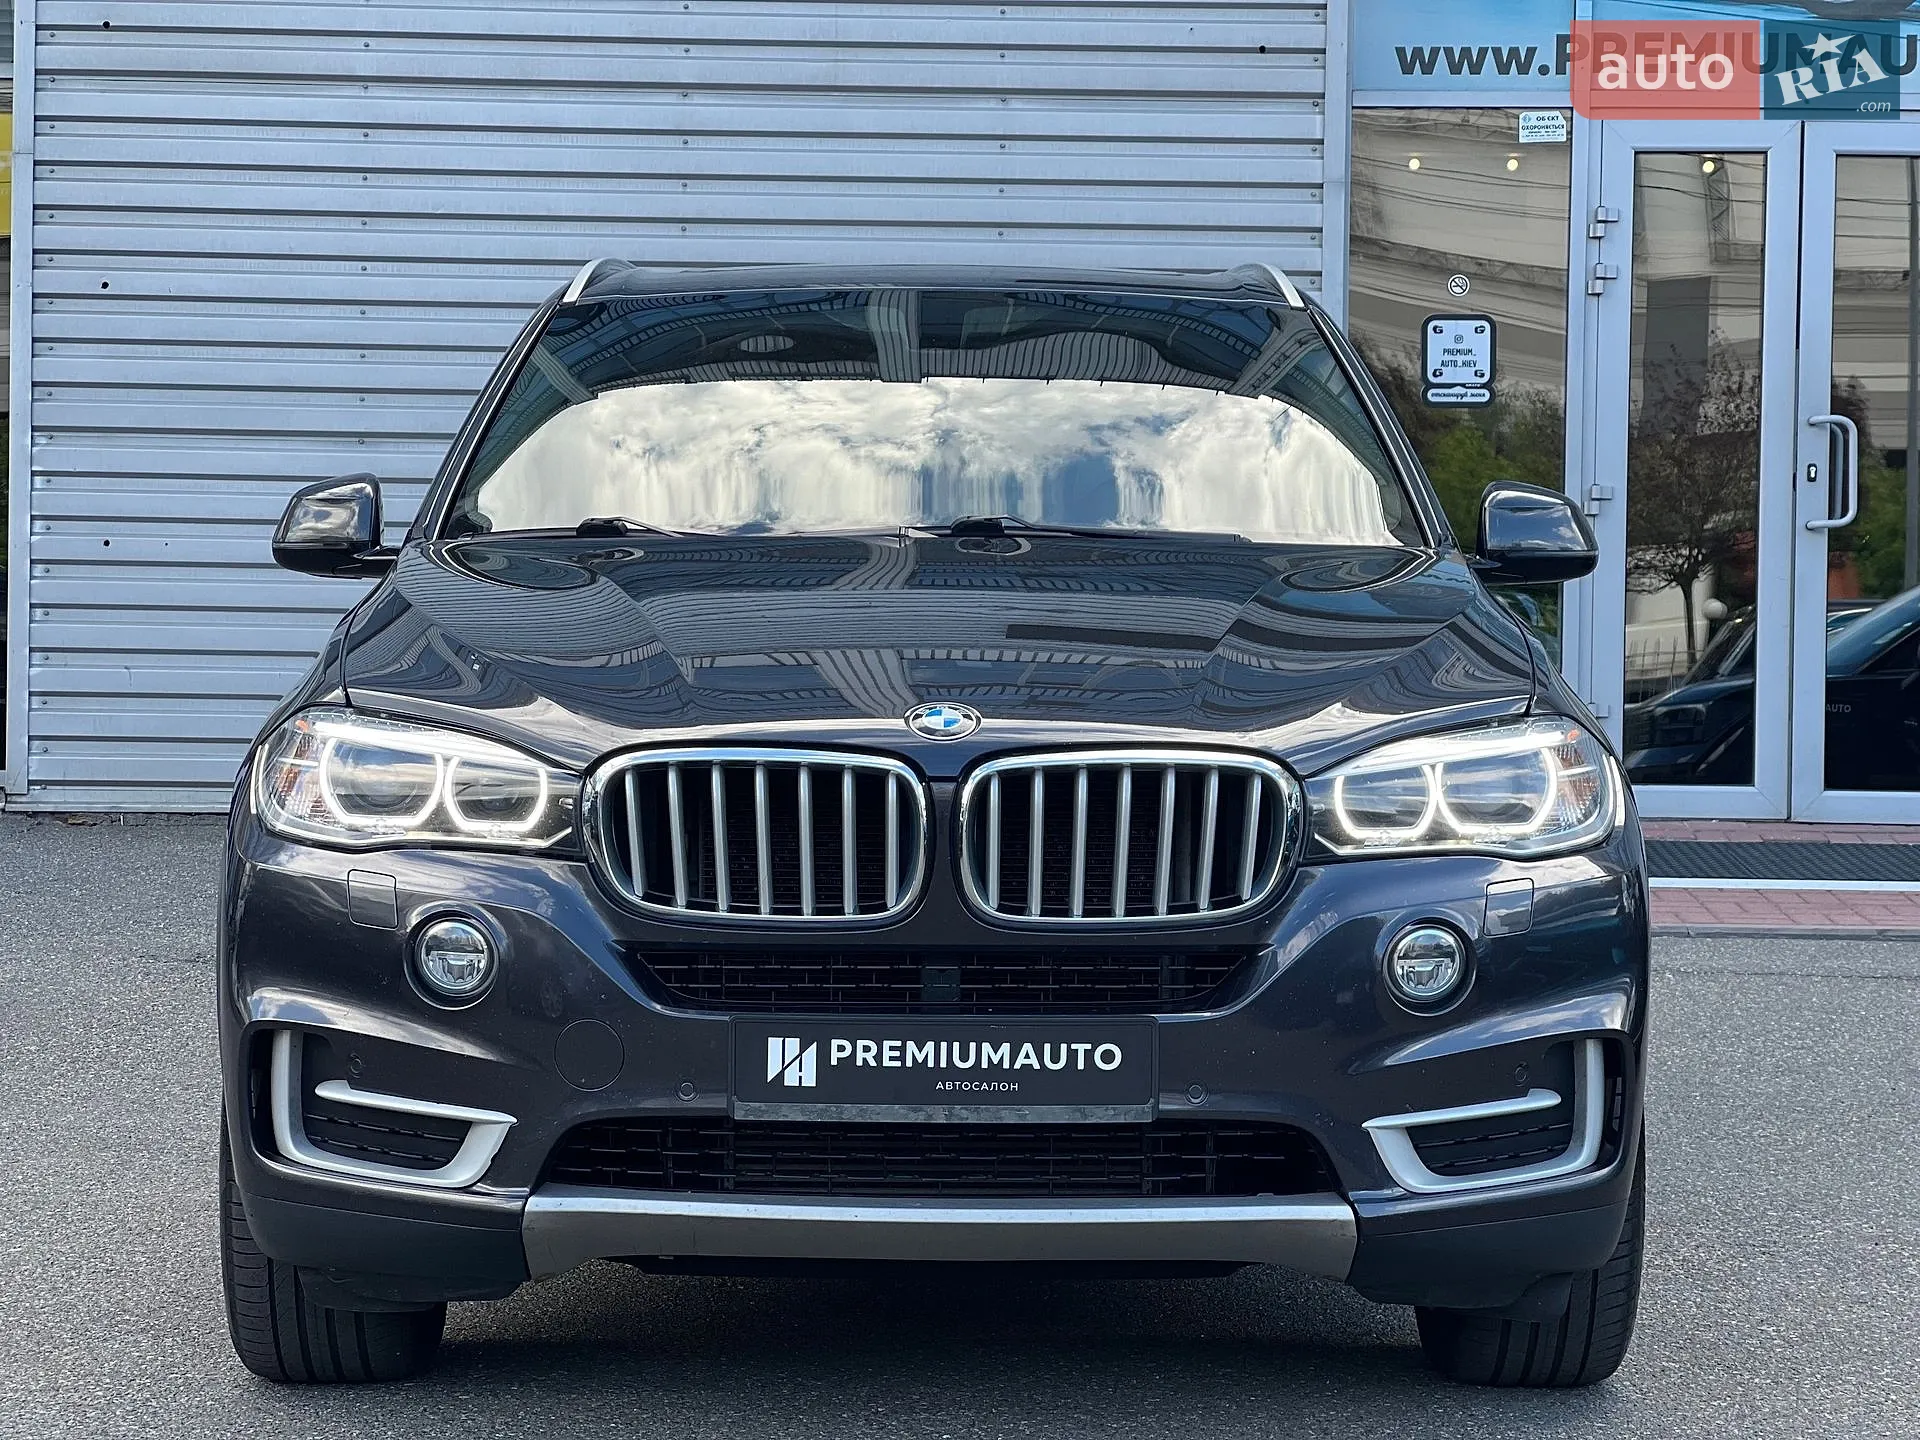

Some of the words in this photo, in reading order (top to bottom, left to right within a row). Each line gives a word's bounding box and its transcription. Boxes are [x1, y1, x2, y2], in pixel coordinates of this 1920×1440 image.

[1825, 703, 1852, 713] AUTO
[830, 1038, 1122, 1071] PREMIUMAUTO
[935, 1080, 1019, 1092] АВТОСАЛОН
